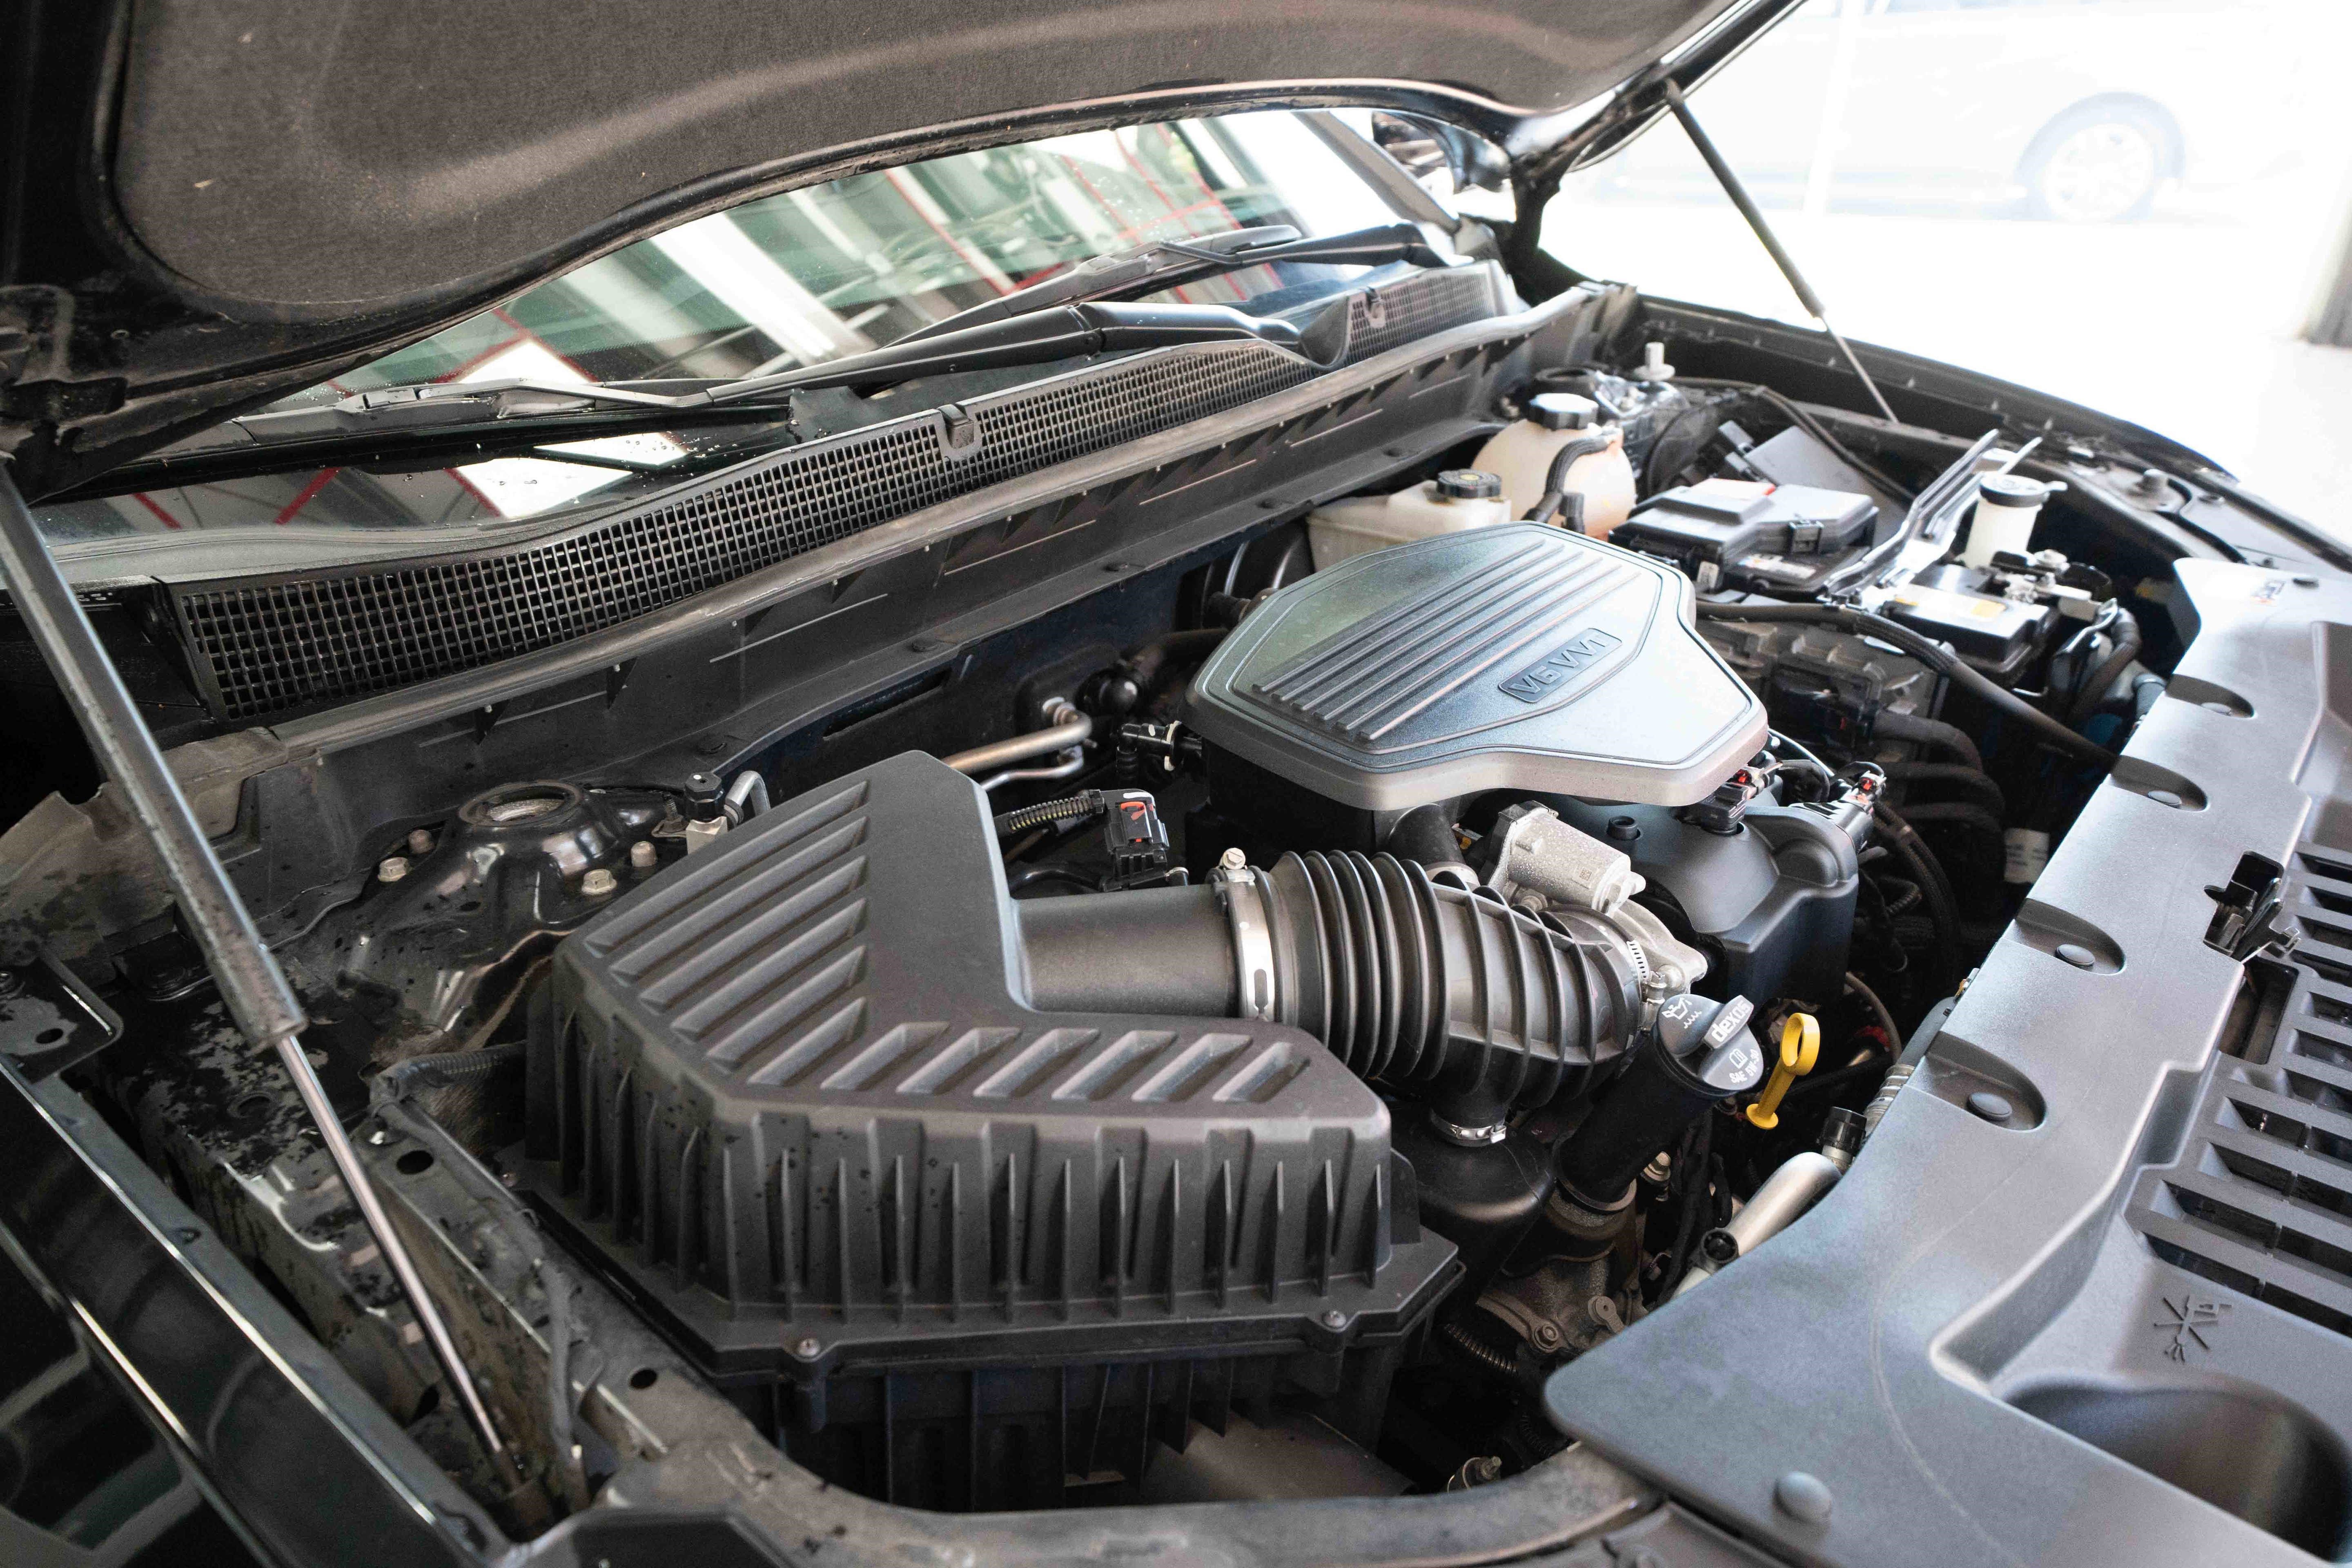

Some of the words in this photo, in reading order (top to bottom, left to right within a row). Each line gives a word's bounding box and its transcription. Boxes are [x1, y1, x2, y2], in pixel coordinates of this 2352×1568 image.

[1509, 666, 1561, 693] V6
[1548, 635, 1608, 668] VVT
[1711, 1000, 1751, 1042] dexos
[1729, 1070, 1748, 1083] SAE
